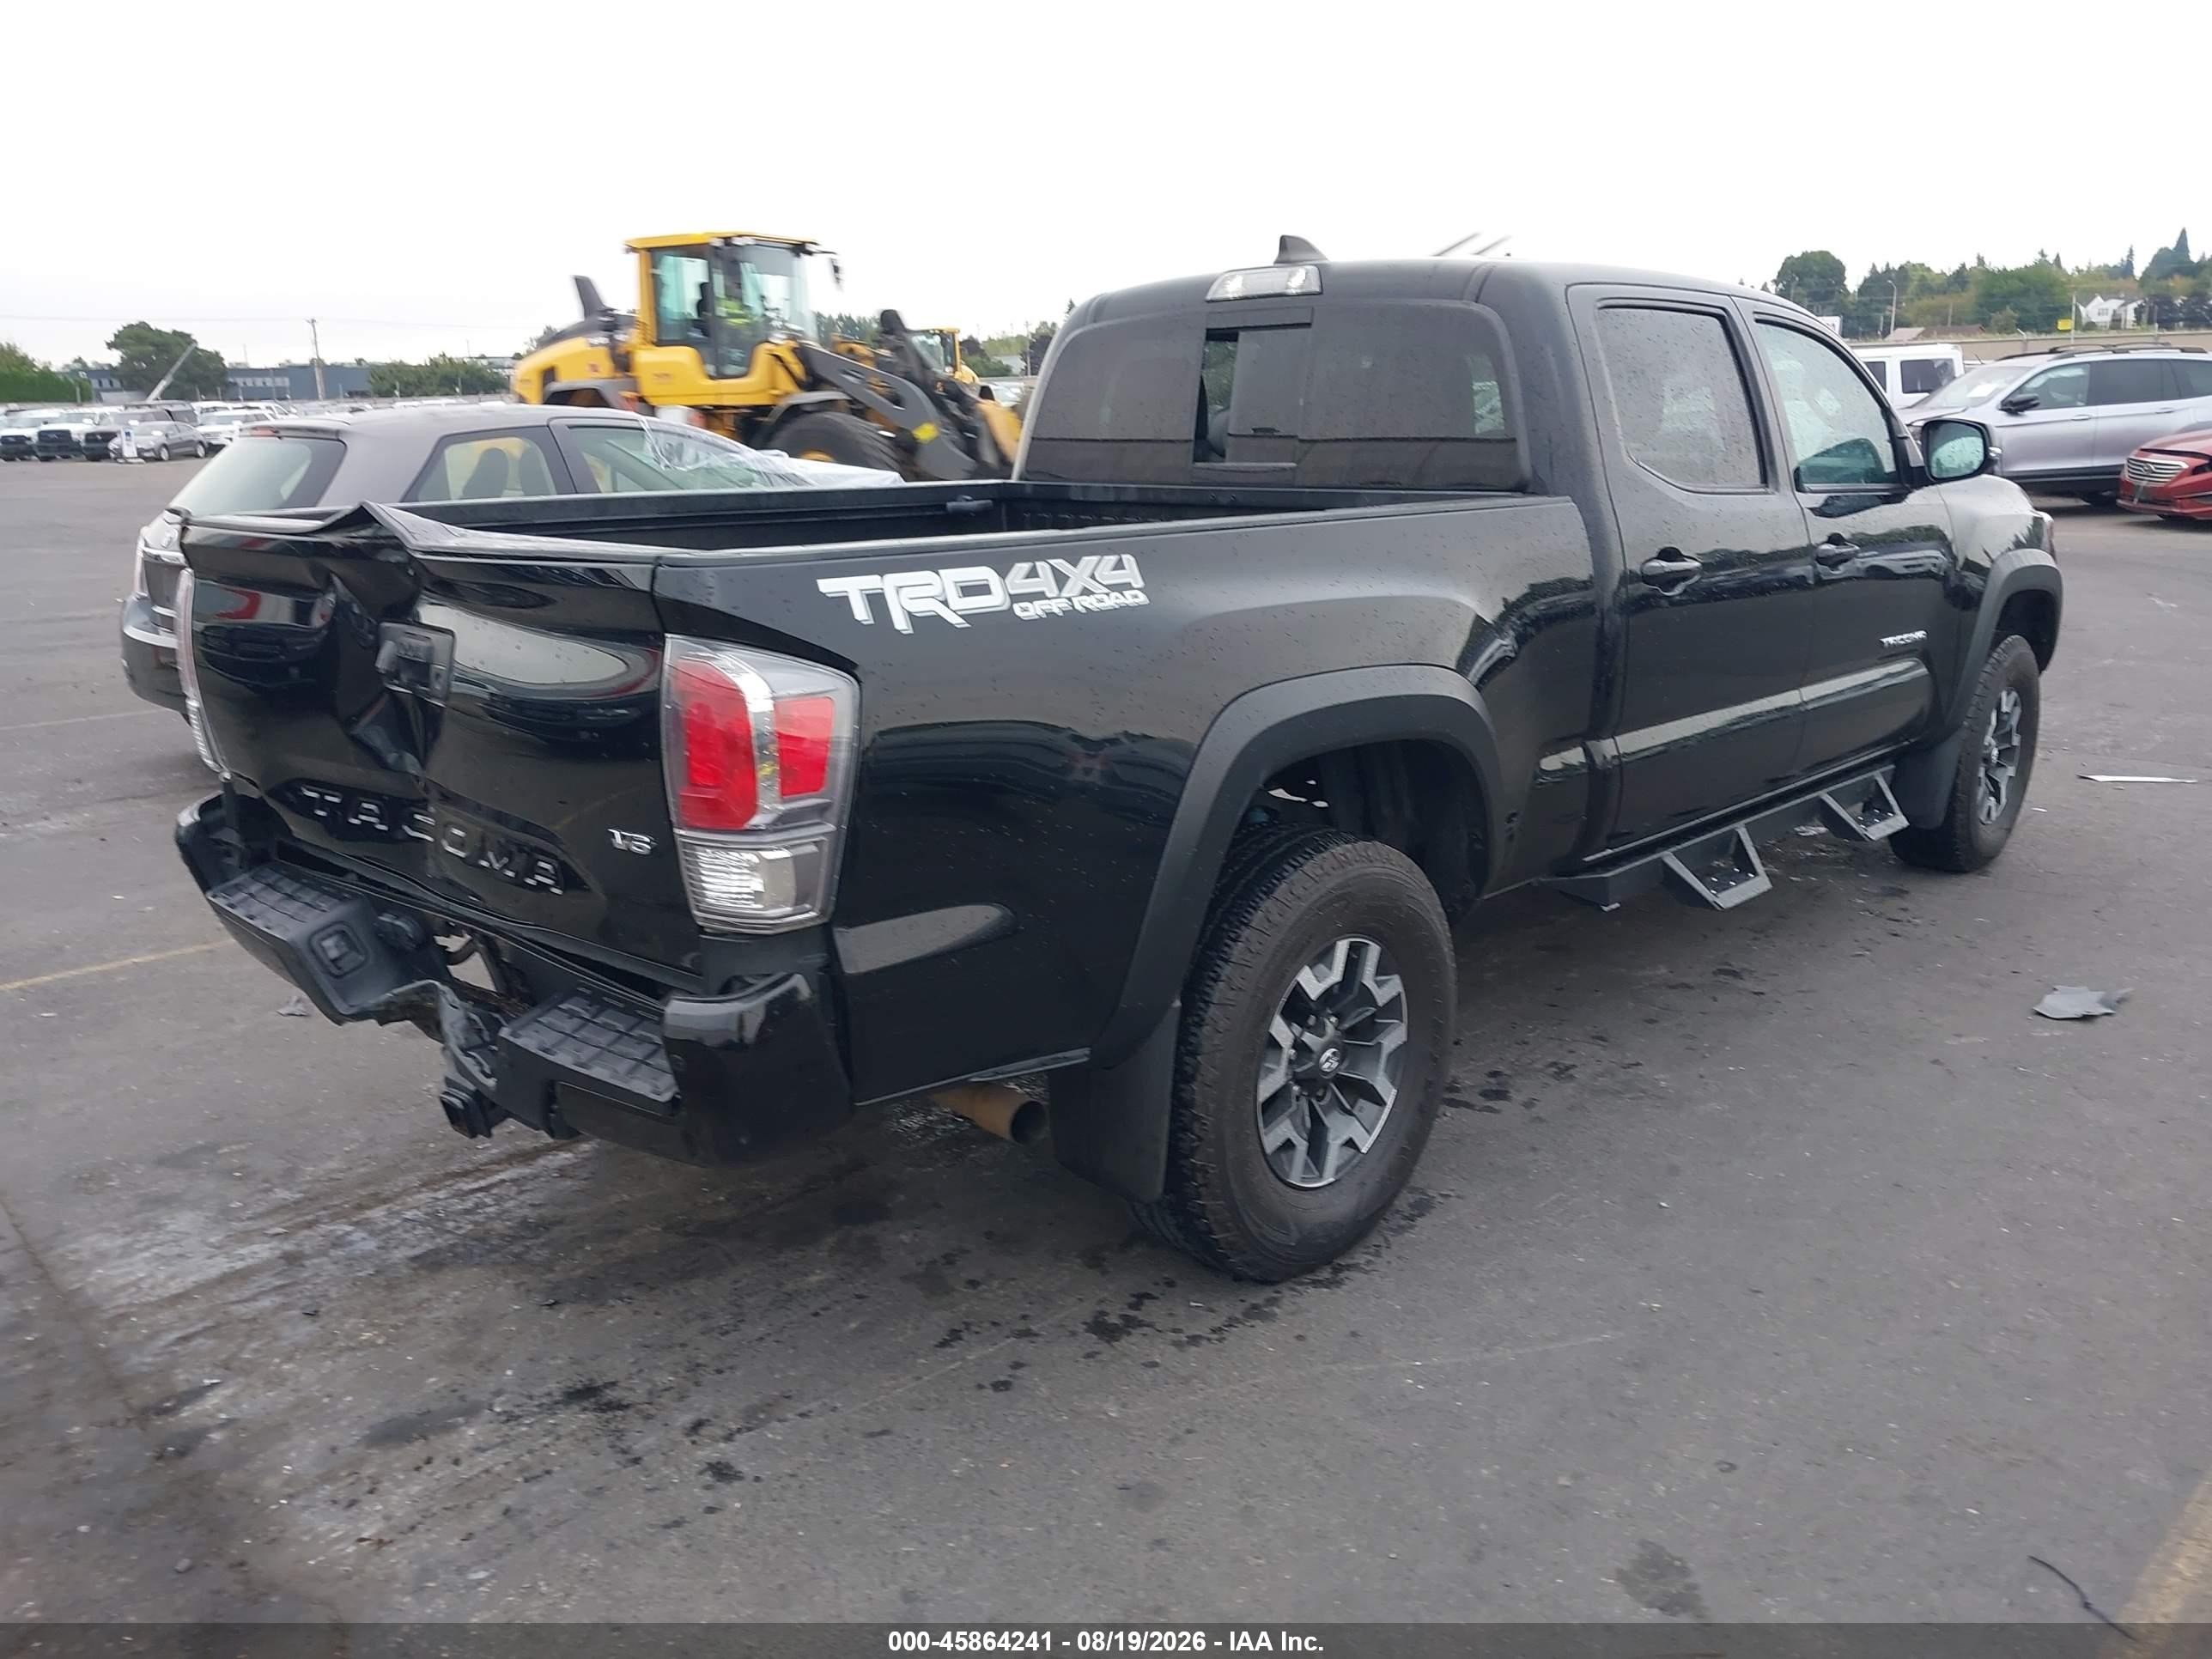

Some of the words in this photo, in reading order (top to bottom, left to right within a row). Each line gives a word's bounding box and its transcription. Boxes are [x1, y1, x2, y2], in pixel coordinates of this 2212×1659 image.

[817, 566, 1011, 635] TRD
[1005, 553, 1146, 599] 4X4
[1012, 597, 1073, 621] OFF
[1071, 589, 1150, 614] ROAD
